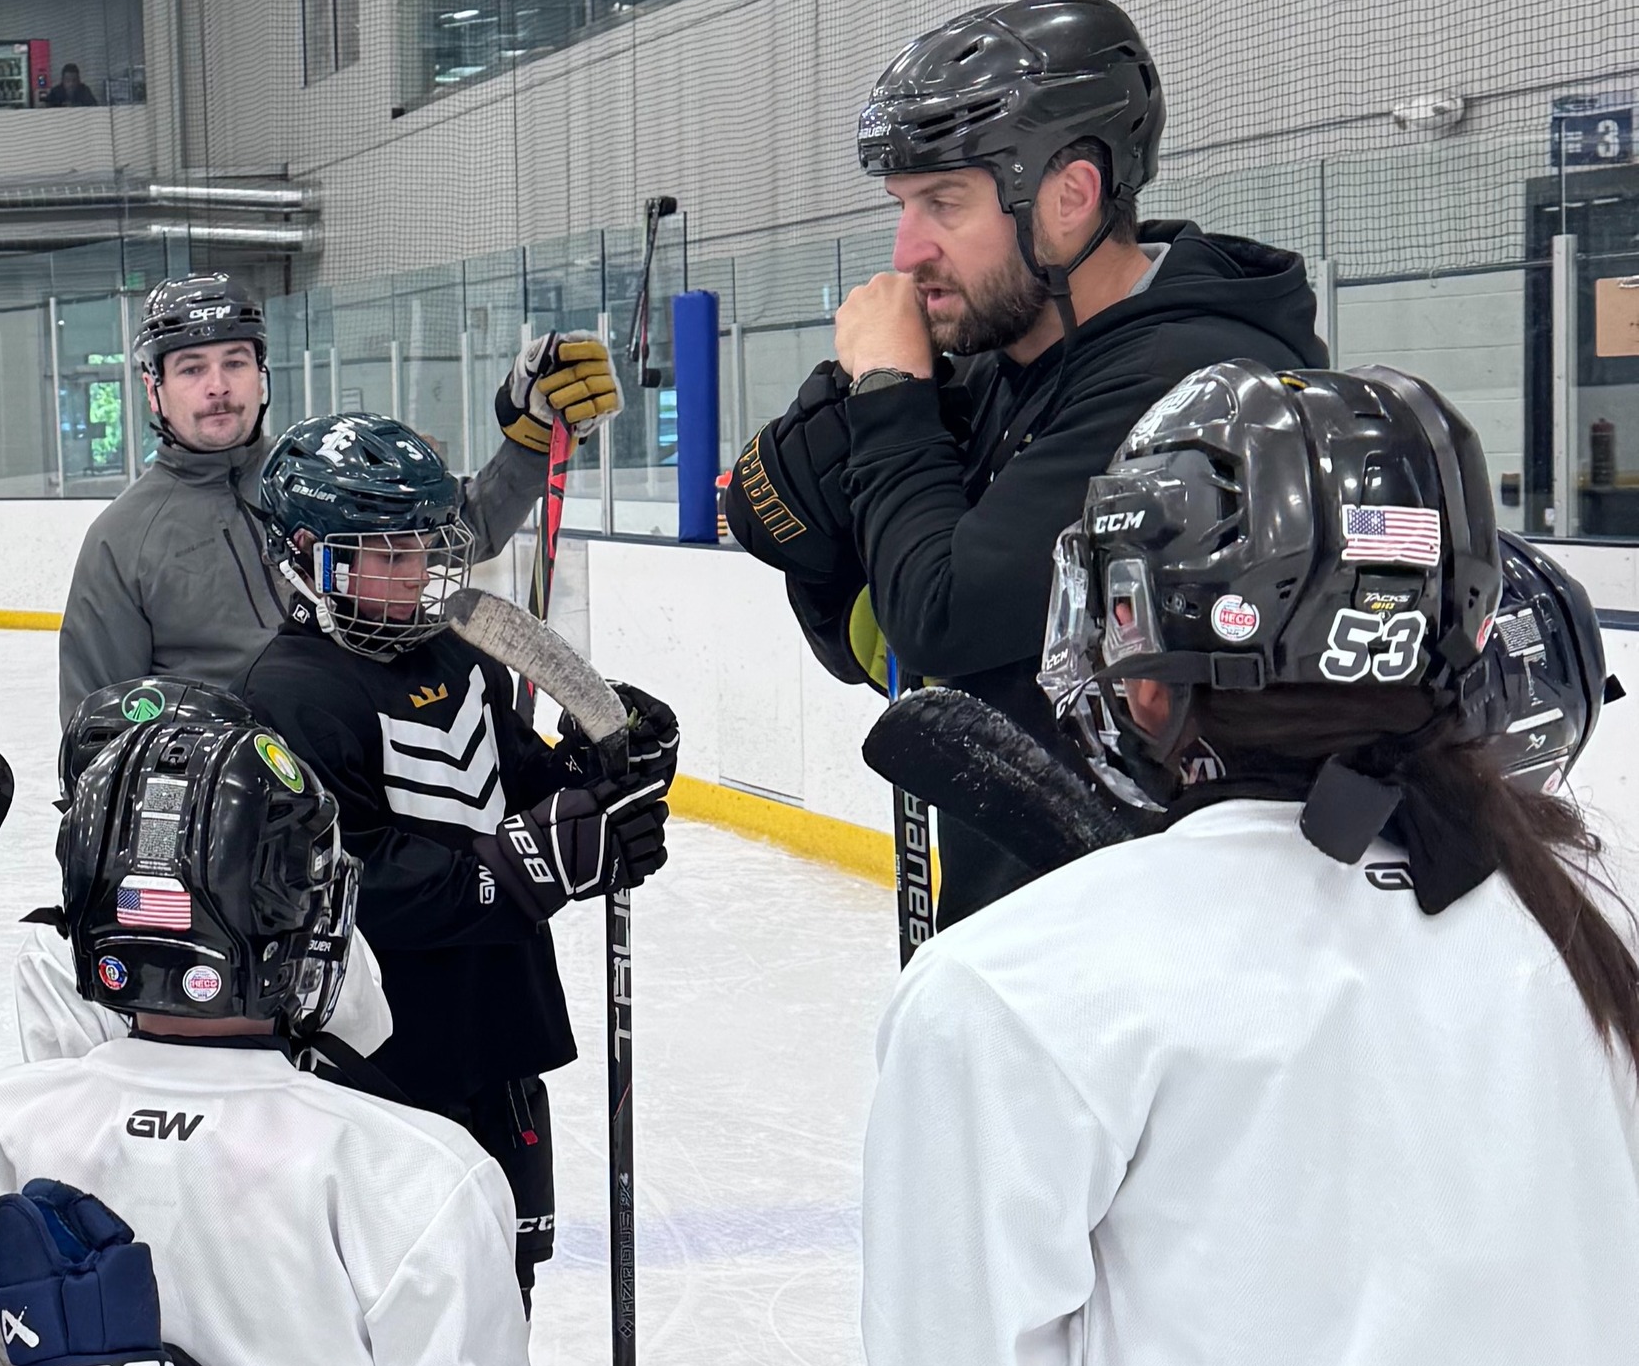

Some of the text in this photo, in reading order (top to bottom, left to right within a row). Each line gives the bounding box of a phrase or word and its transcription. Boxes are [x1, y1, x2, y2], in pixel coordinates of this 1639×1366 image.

[1595, 119, 1620, 159] 3
[1094, 510, 1146, 534] CCM
[1363, 592, 1410, 604] TACKS
[1318, 608, 1427, 683] 53
[1046, 648, 1069, 671] CCM
[126, 1108, 205, 1141] GW
[516, 1214, 555, 1233] CC
